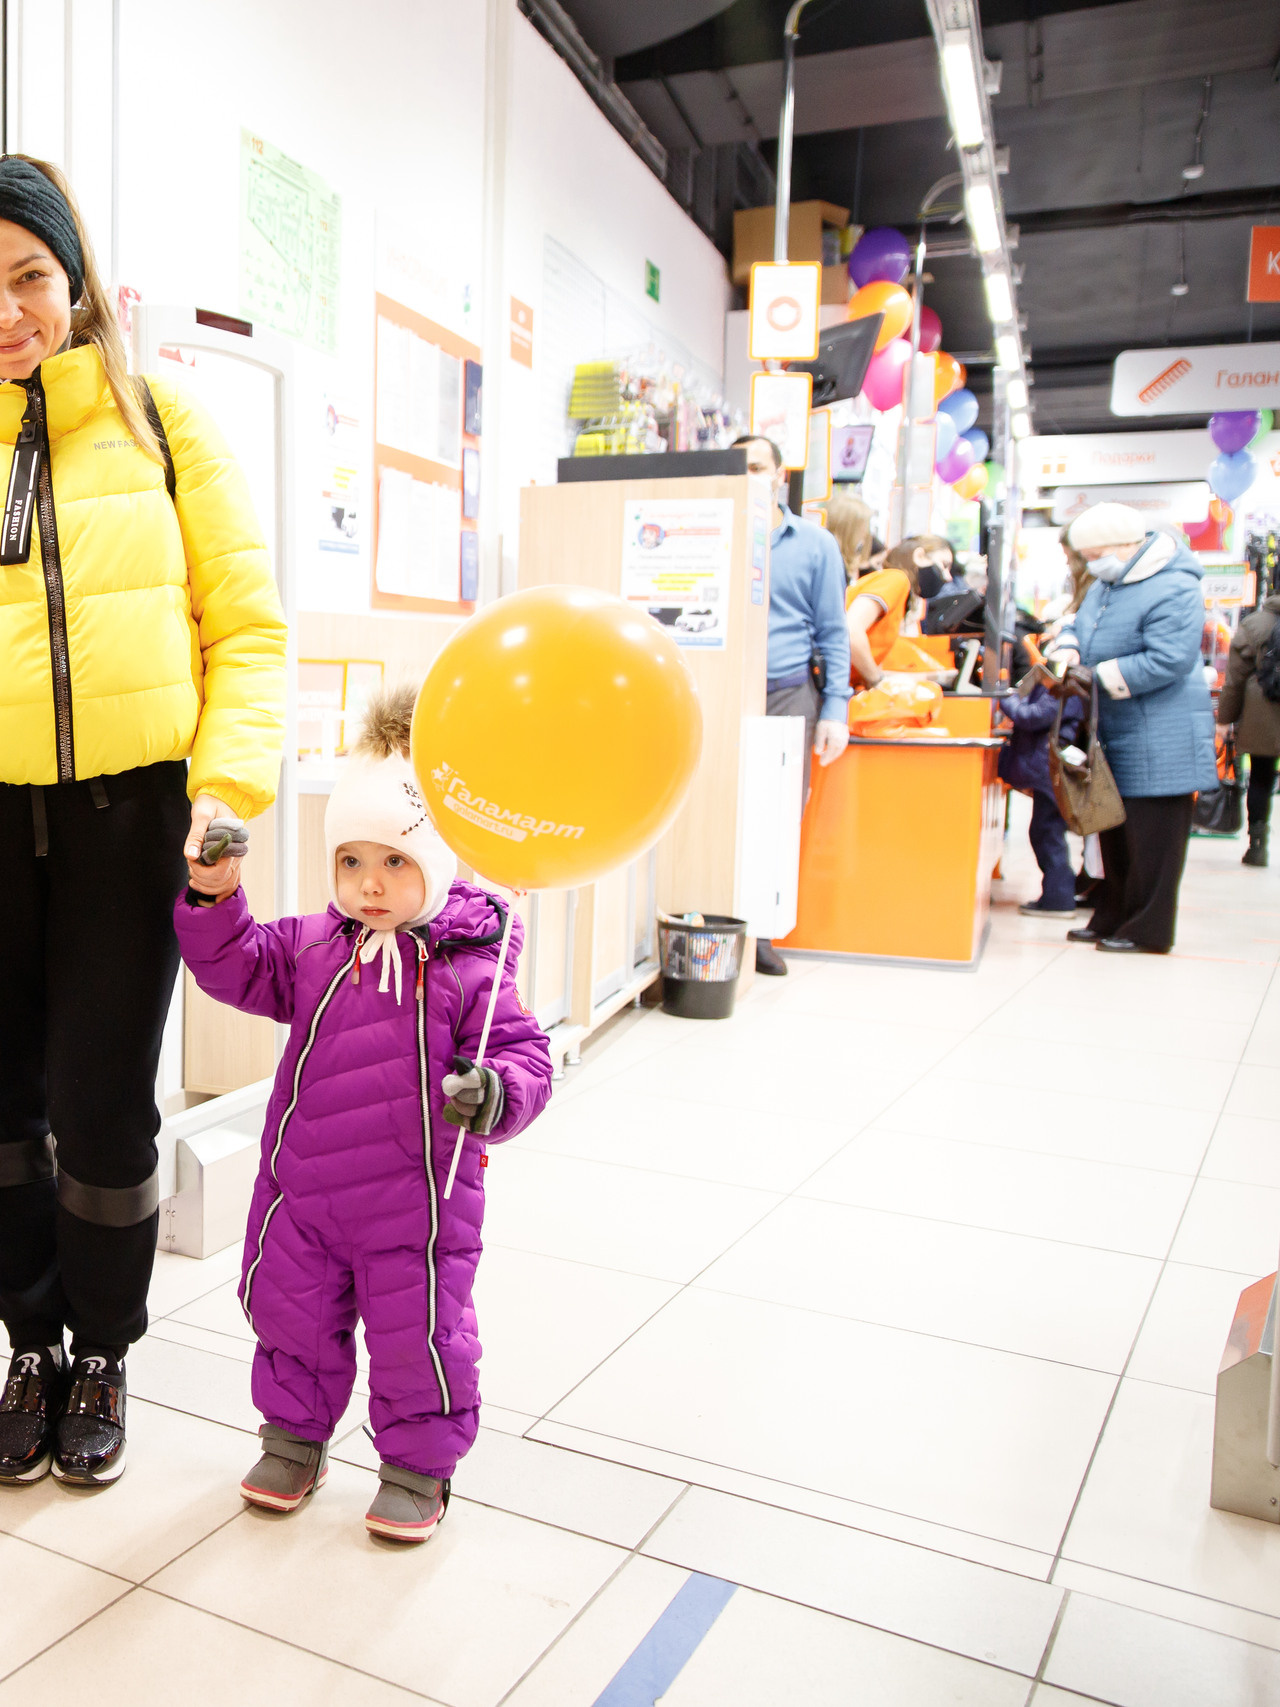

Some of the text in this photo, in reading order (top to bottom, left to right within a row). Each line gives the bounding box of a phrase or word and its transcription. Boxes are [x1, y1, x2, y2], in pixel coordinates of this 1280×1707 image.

[251, 137, 264, 155] 112
[1215, 369, 1280, 389] Галан
[93, 440, 116, 450] NEW
[9, 499, 23, 541] FASHION
[448, 777, 585, 839] Галамарт
